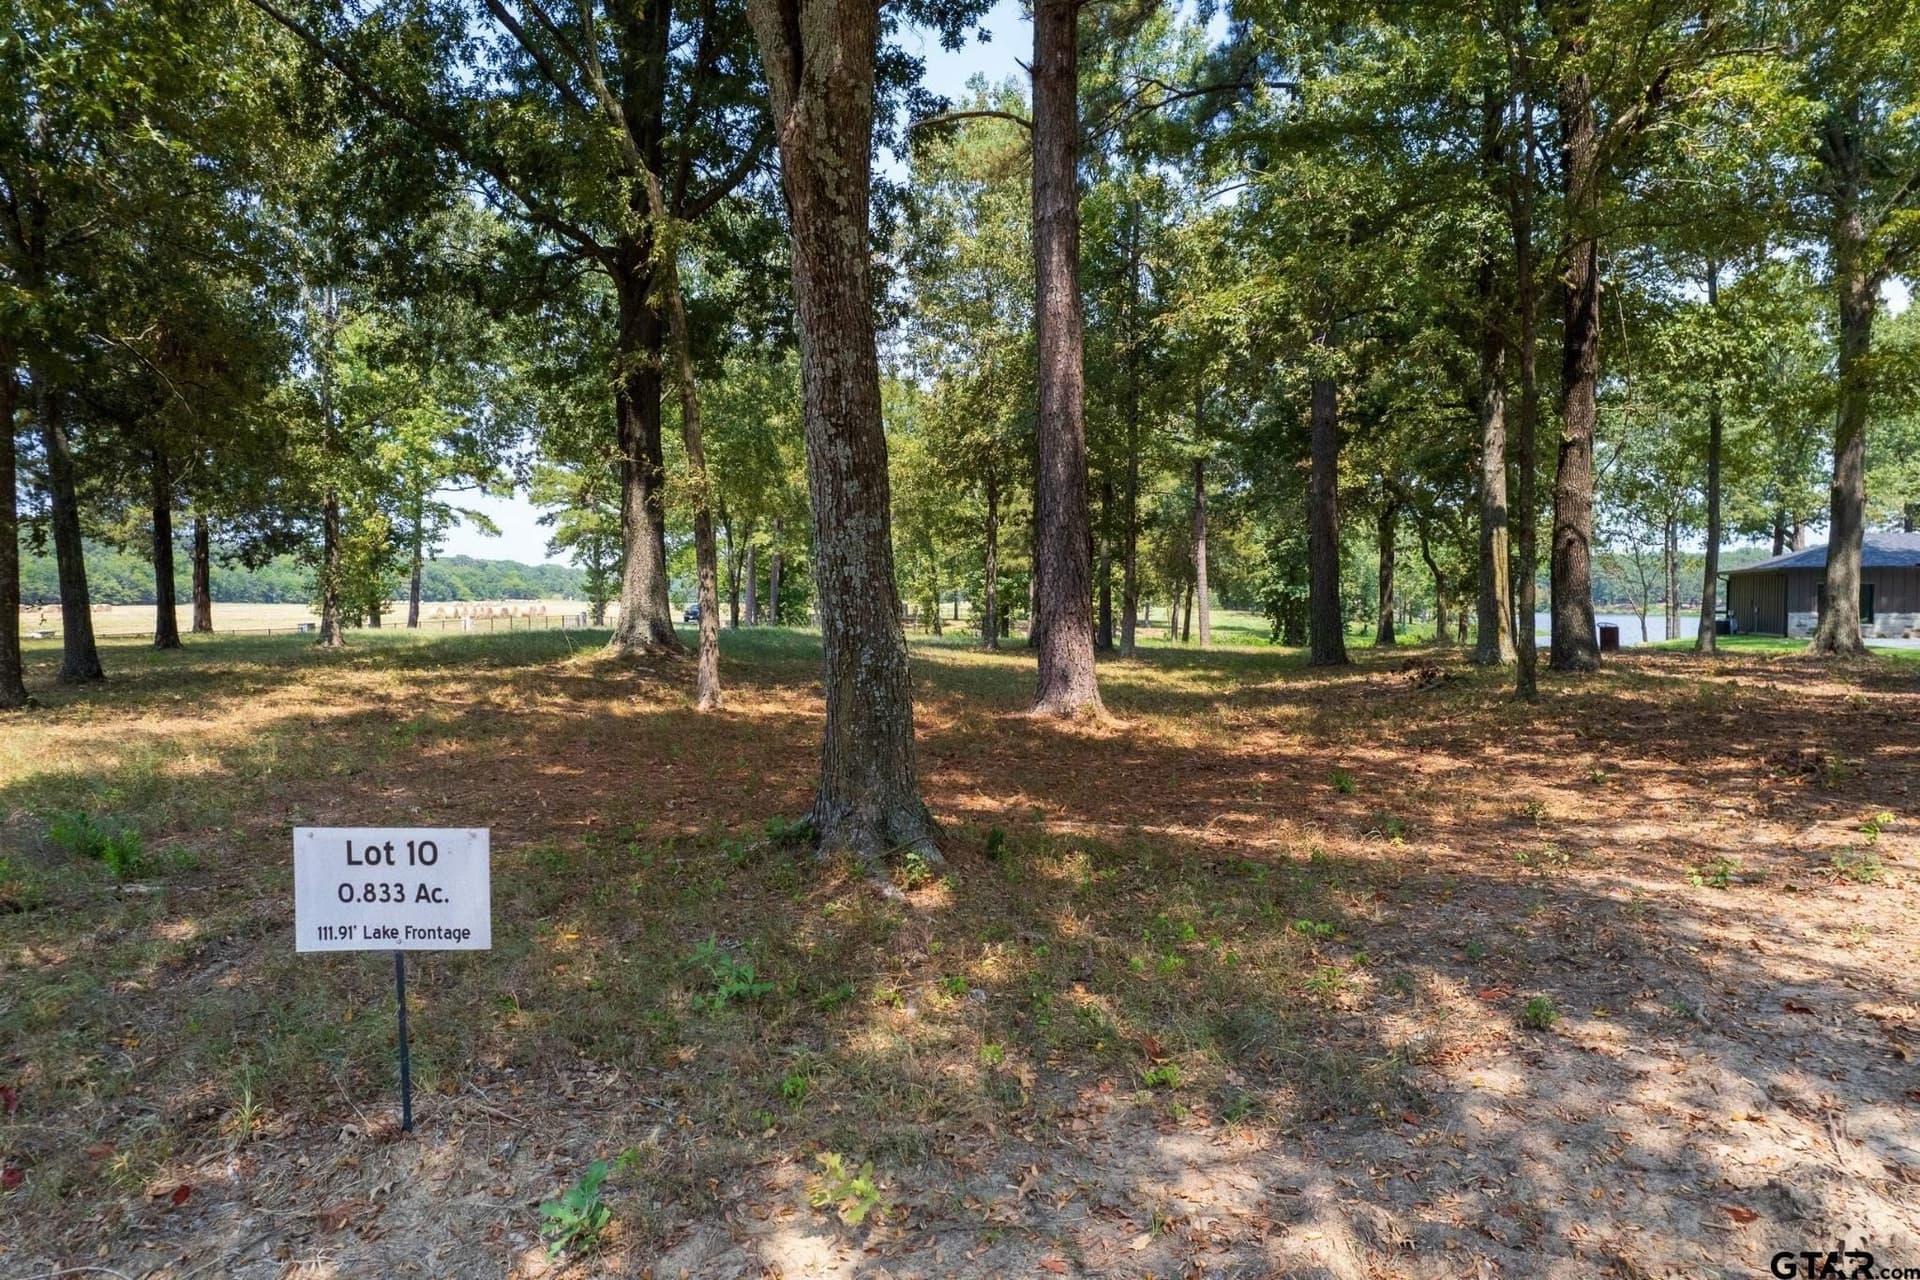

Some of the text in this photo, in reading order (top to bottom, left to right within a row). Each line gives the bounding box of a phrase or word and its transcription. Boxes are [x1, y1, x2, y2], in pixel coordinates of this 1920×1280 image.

[346, 840, 438, 866] Lot 10
[338, 883, 449, 903] 0.833 Ac.
[317, 925, 471, 944] 111.91' Lake Frontage
